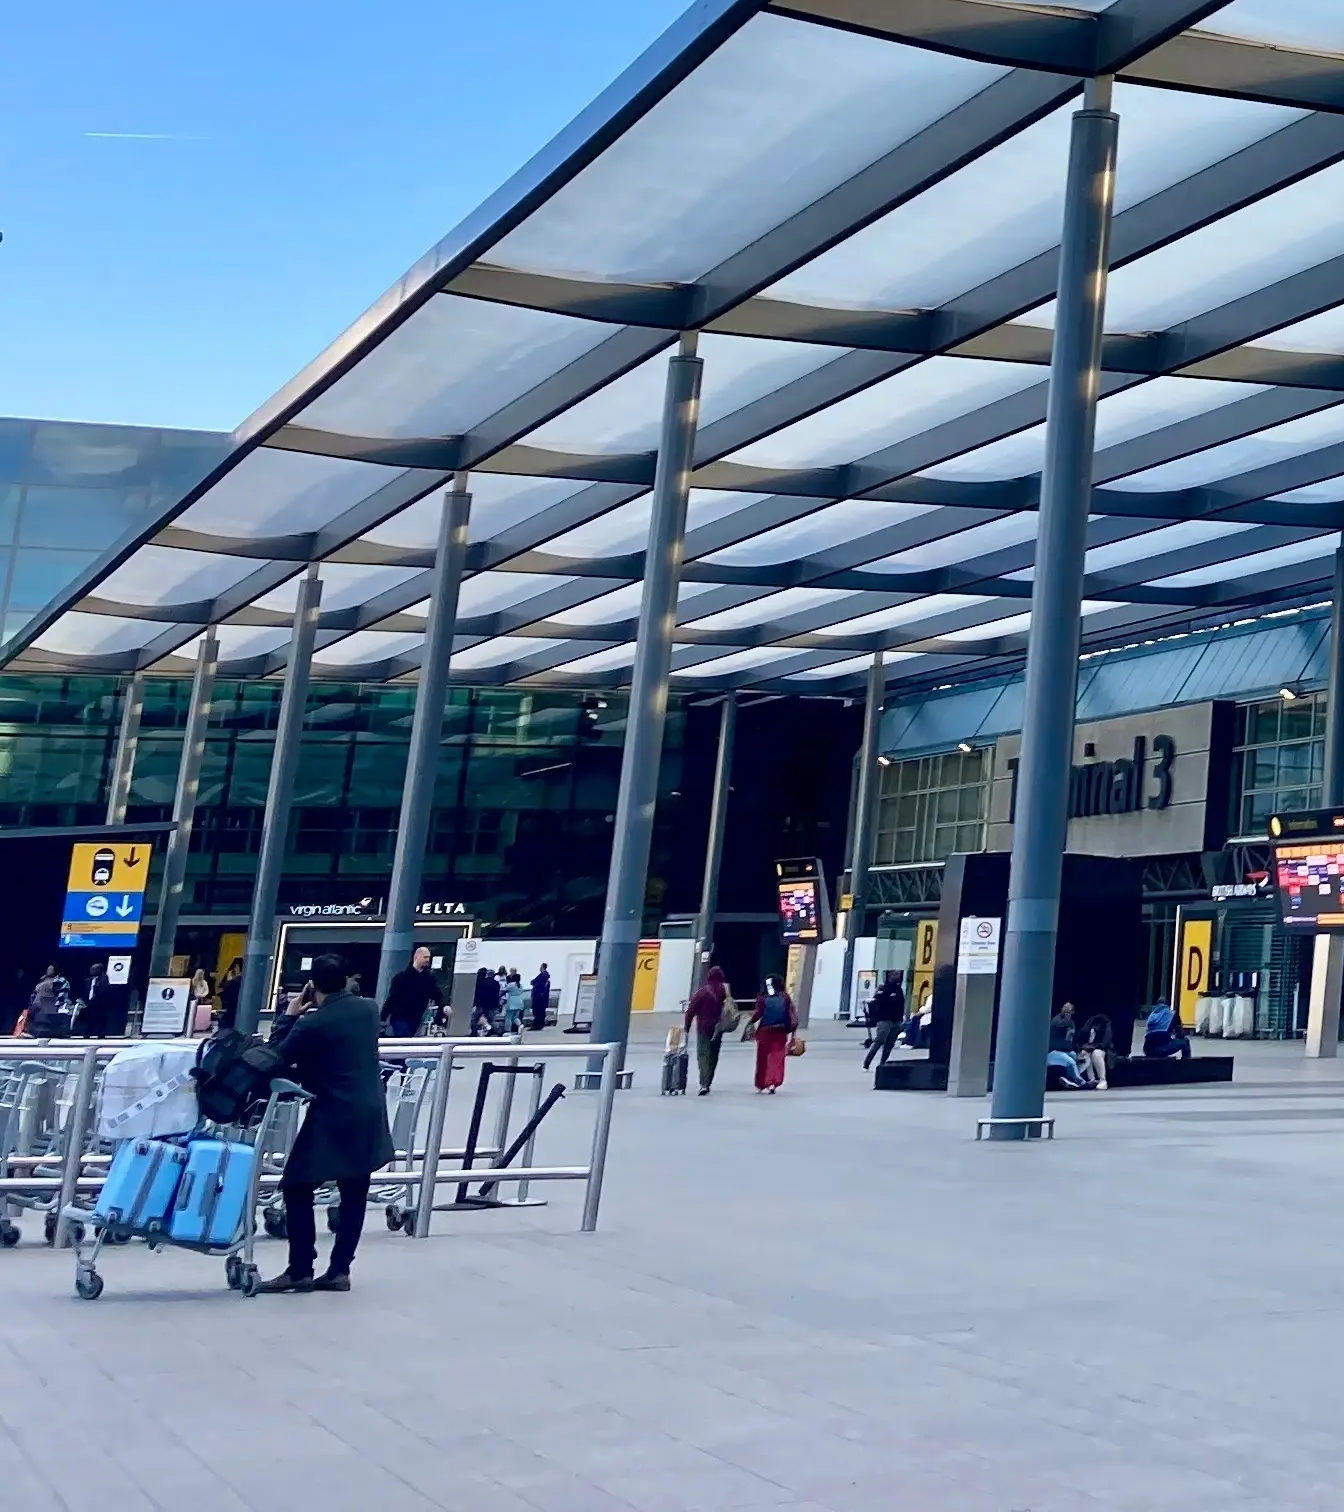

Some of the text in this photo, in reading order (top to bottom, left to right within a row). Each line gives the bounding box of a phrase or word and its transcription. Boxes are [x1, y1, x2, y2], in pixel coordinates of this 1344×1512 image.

[1148, 734, 1176, 810] 3
[289, 903, 362, 917] virgin atlantic
[415, 902, 466, 915] ELTA
[922, 924, 934, 965] B
[1186, 946, 1203, 991] D
